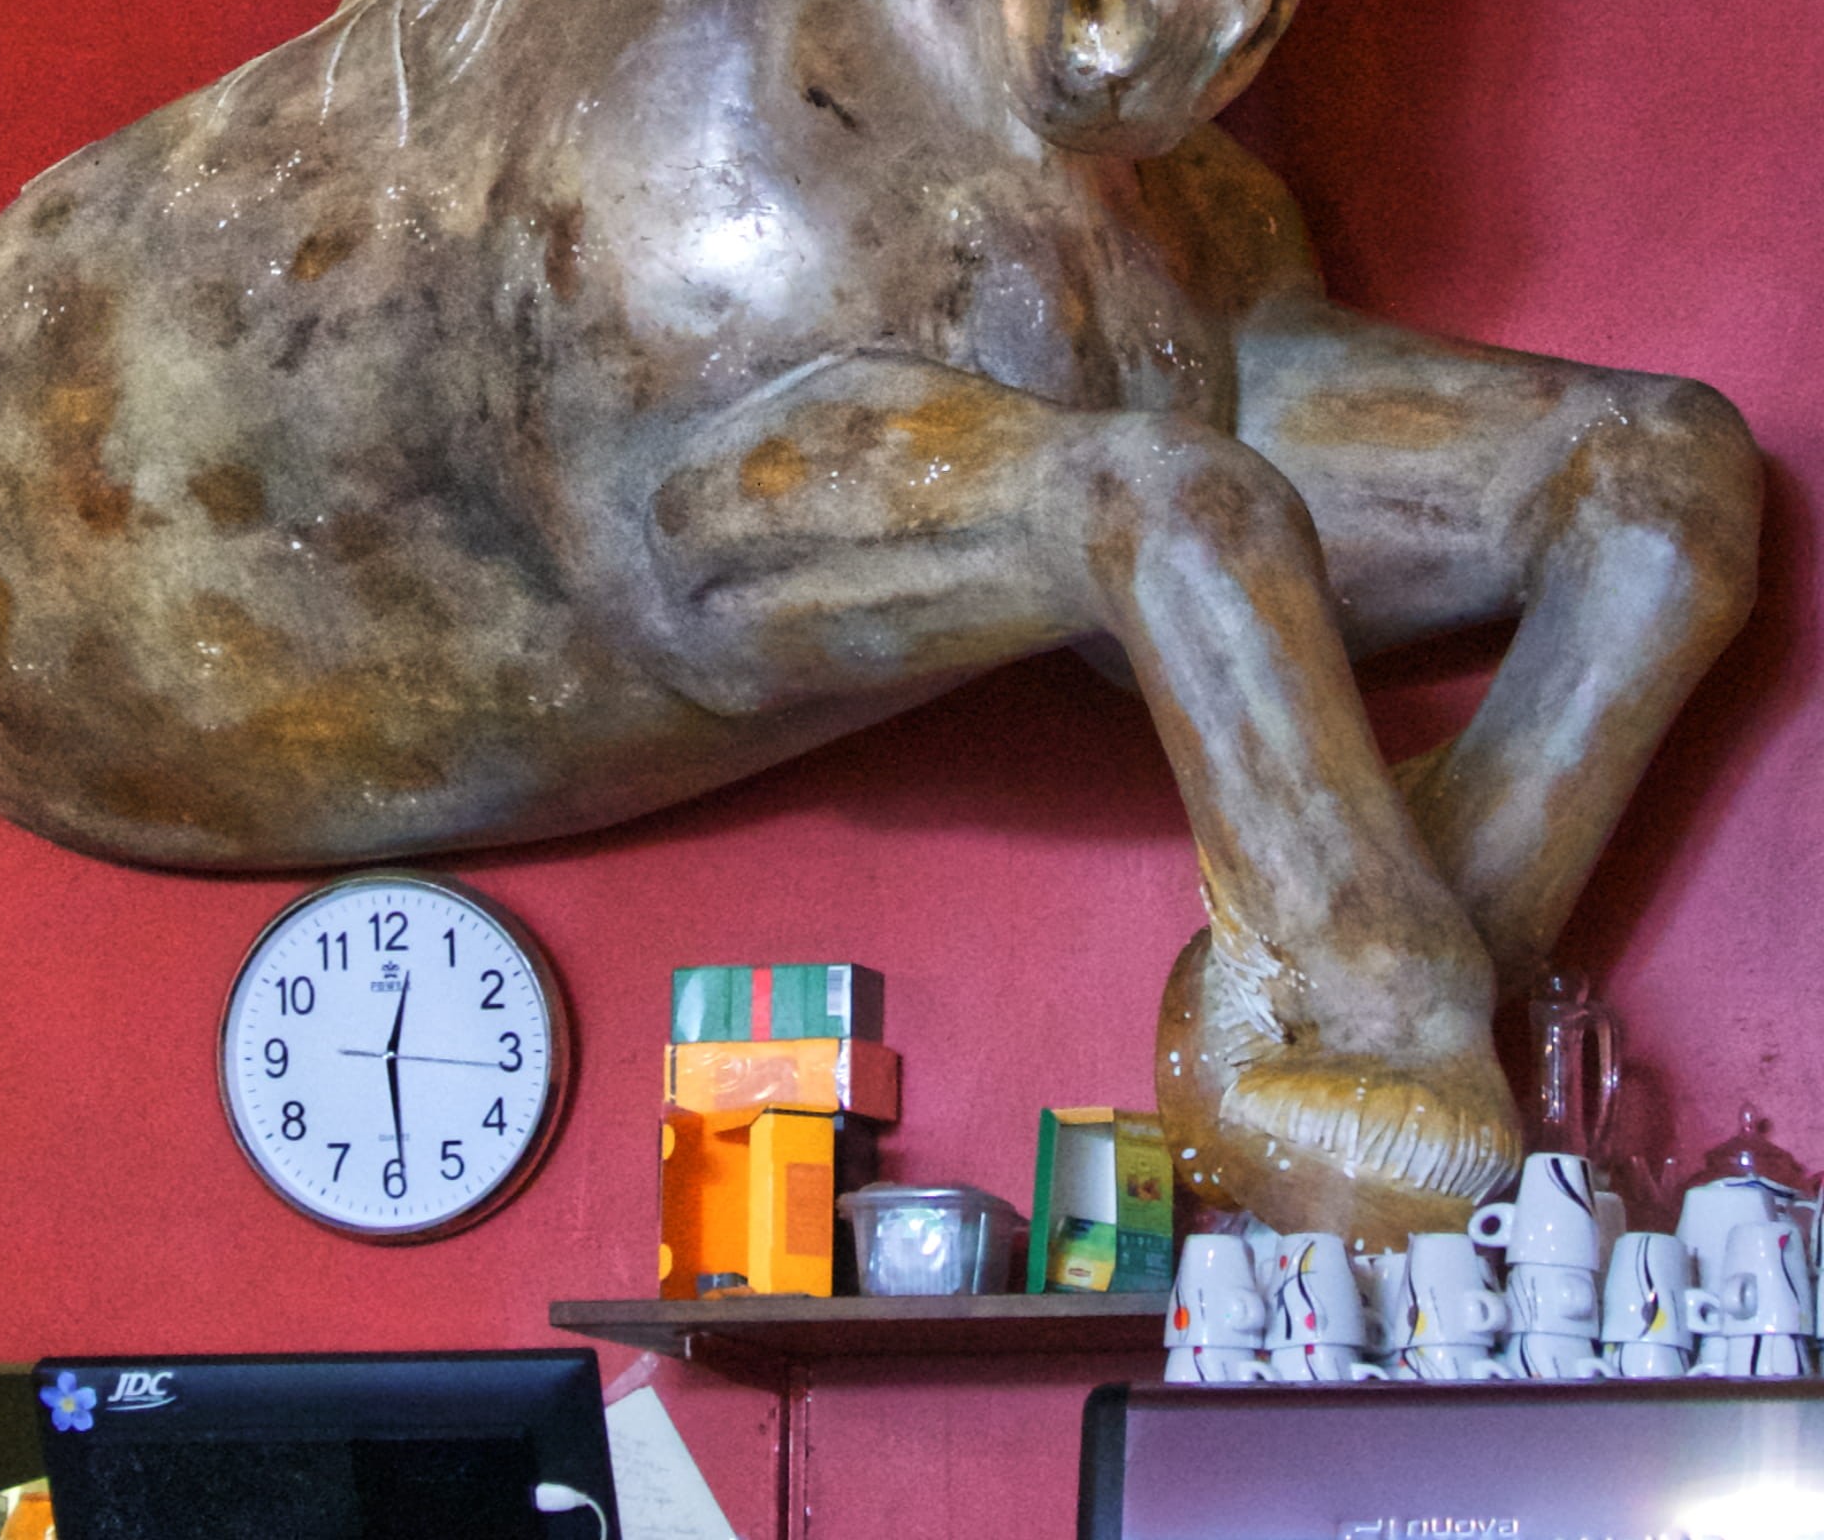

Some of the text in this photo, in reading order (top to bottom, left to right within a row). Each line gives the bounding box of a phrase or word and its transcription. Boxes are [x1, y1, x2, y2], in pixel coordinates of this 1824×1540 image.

[317, 931, 348, 971] 11
[369, 912, 409, 951] 12
[443, 927, 456, 968] 1
[275, 976, 315, 1016] 10
[480, 969, 505, 1010] 2
[264, 1037, 289, 1079] 9
[498, 1031, 523, 1073] 3
[281, 1100, 307, 1142] 8
[482, 1096, 508, 1136] 4
[327, 1142, 351, 1182] 7
[382, 1158, 407, 1200] 6
[440, 1139, 465, 1181] 5
[107, 1371, 174, 1402] JDC
[1407, 1518, 1519, 1538] nuova
